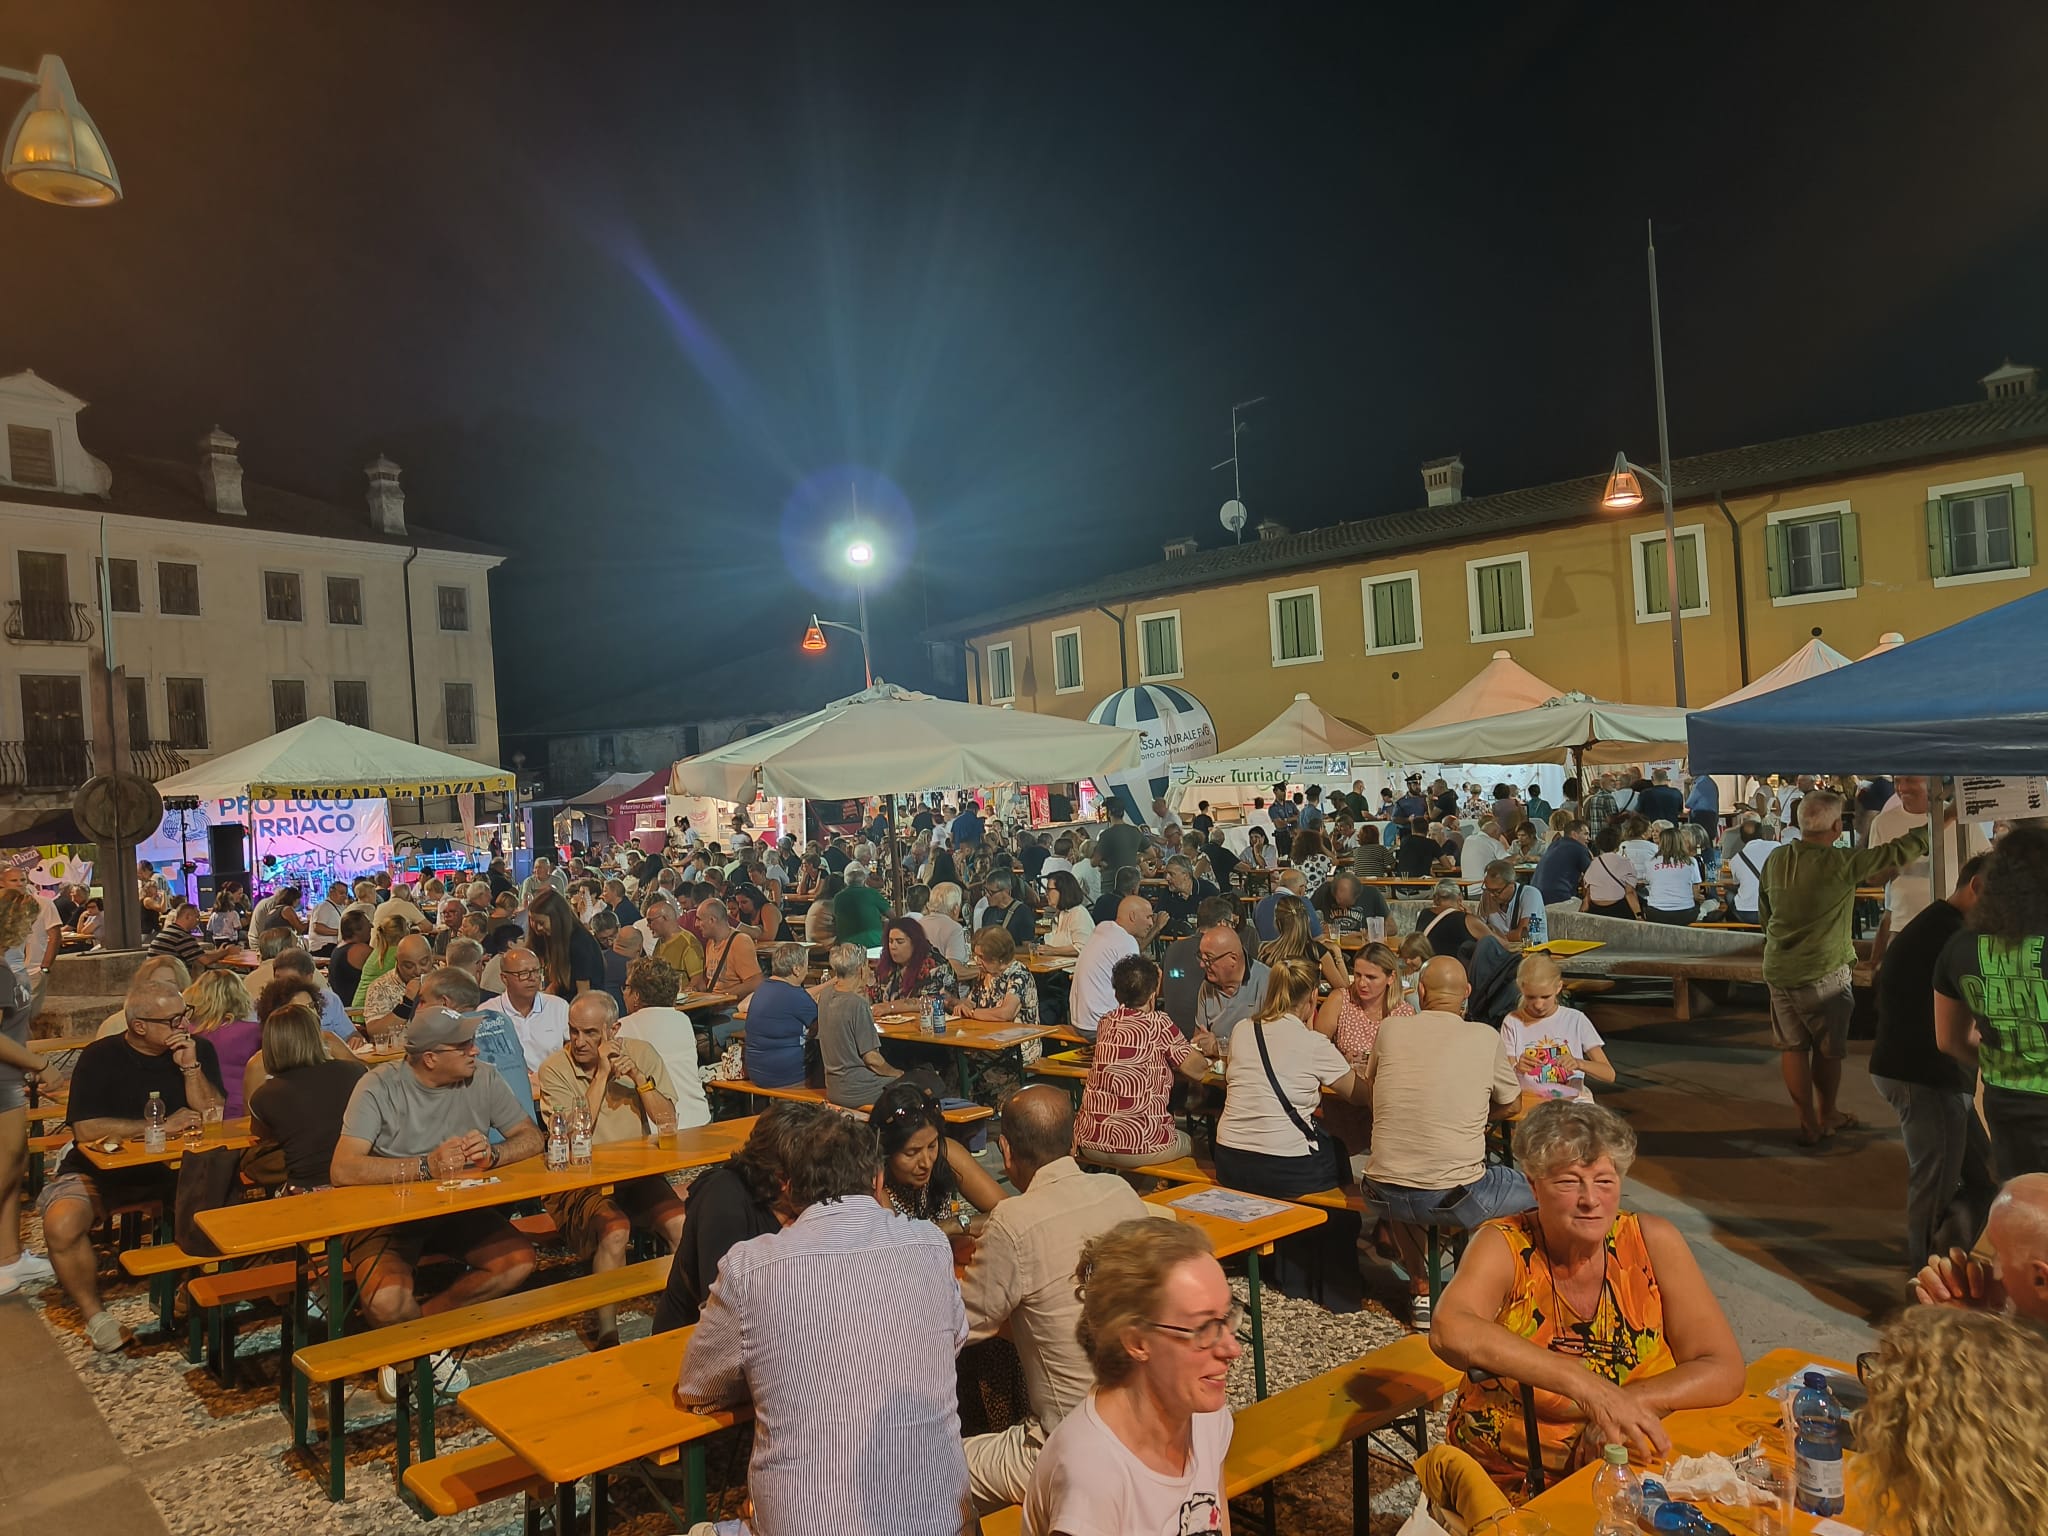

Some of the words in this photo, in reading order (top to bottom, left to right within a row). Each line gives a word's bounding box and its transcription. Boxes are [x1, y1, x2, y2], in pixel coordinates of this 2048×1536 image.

[1163, 729, 1198, 747] RURALE
[1198, 725, 1211, 738] FVG
[1195, 774, 1226, 784] auser
[1230, 767, 1291, 783] Turriaco
[395, 786, 412, 798] in
[420, 780, 488, 796] PIAZZA
[218, 795, 275, 817] PRO
[284, 799, 354, 813] LOCO
[340, 847, 375, 865] FVG
[1654, 862, 1686, 871] STAFF
[1977, 934, 2046, 980] WE
